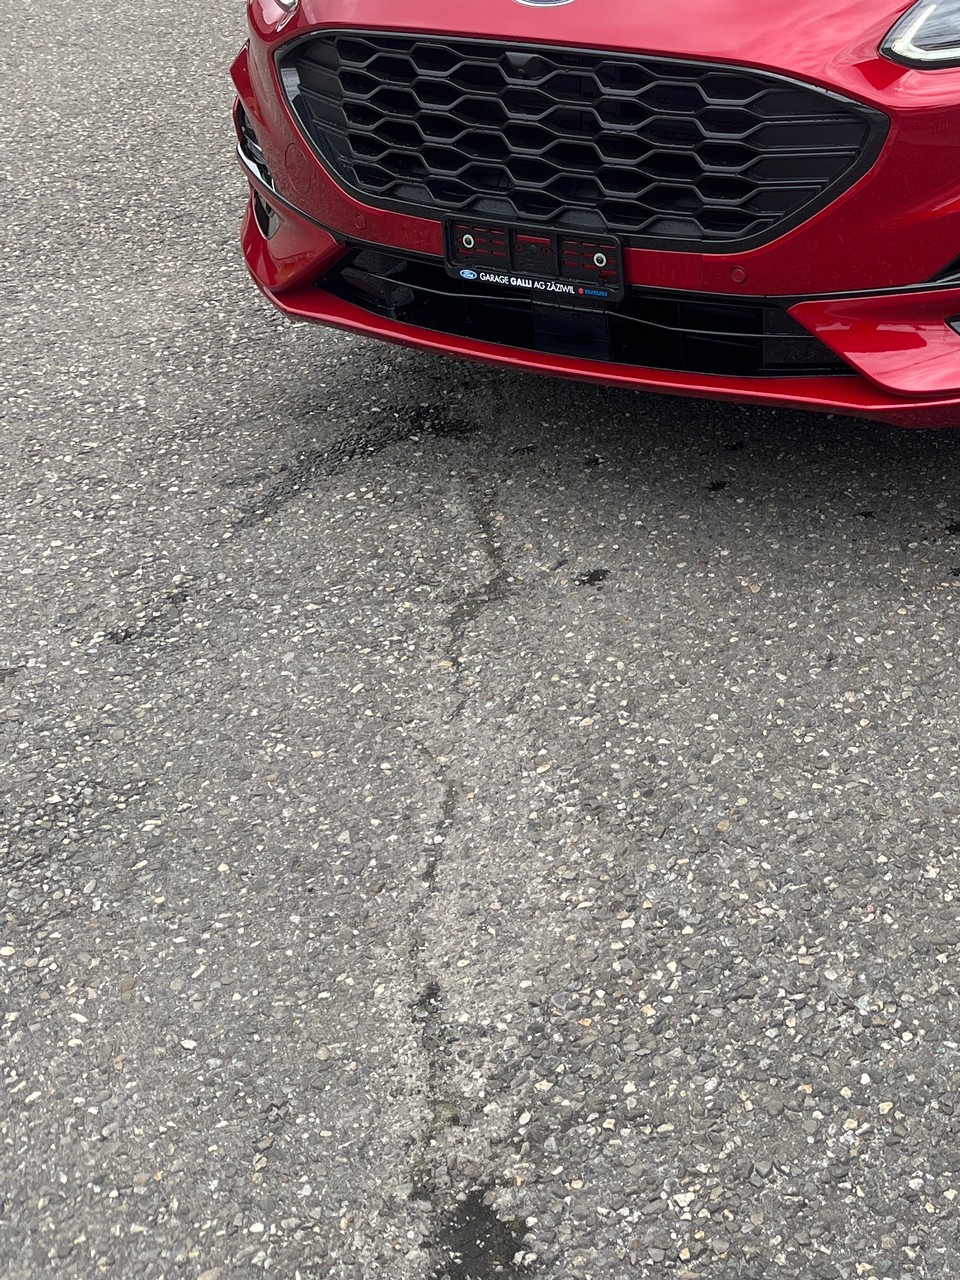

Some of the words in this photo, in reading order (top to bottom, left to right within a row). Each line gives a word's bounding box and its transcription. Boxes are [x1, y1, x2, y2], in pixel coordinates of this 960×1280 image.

[479, 272, 510, 285] GARAGE
[510, 277, 532, 288] GALLI
[533, 281, 546, 290] AG
[546, 281, 576, 295] ZÄZIWIL
[584, 288, 608, 297] SUZUKI
